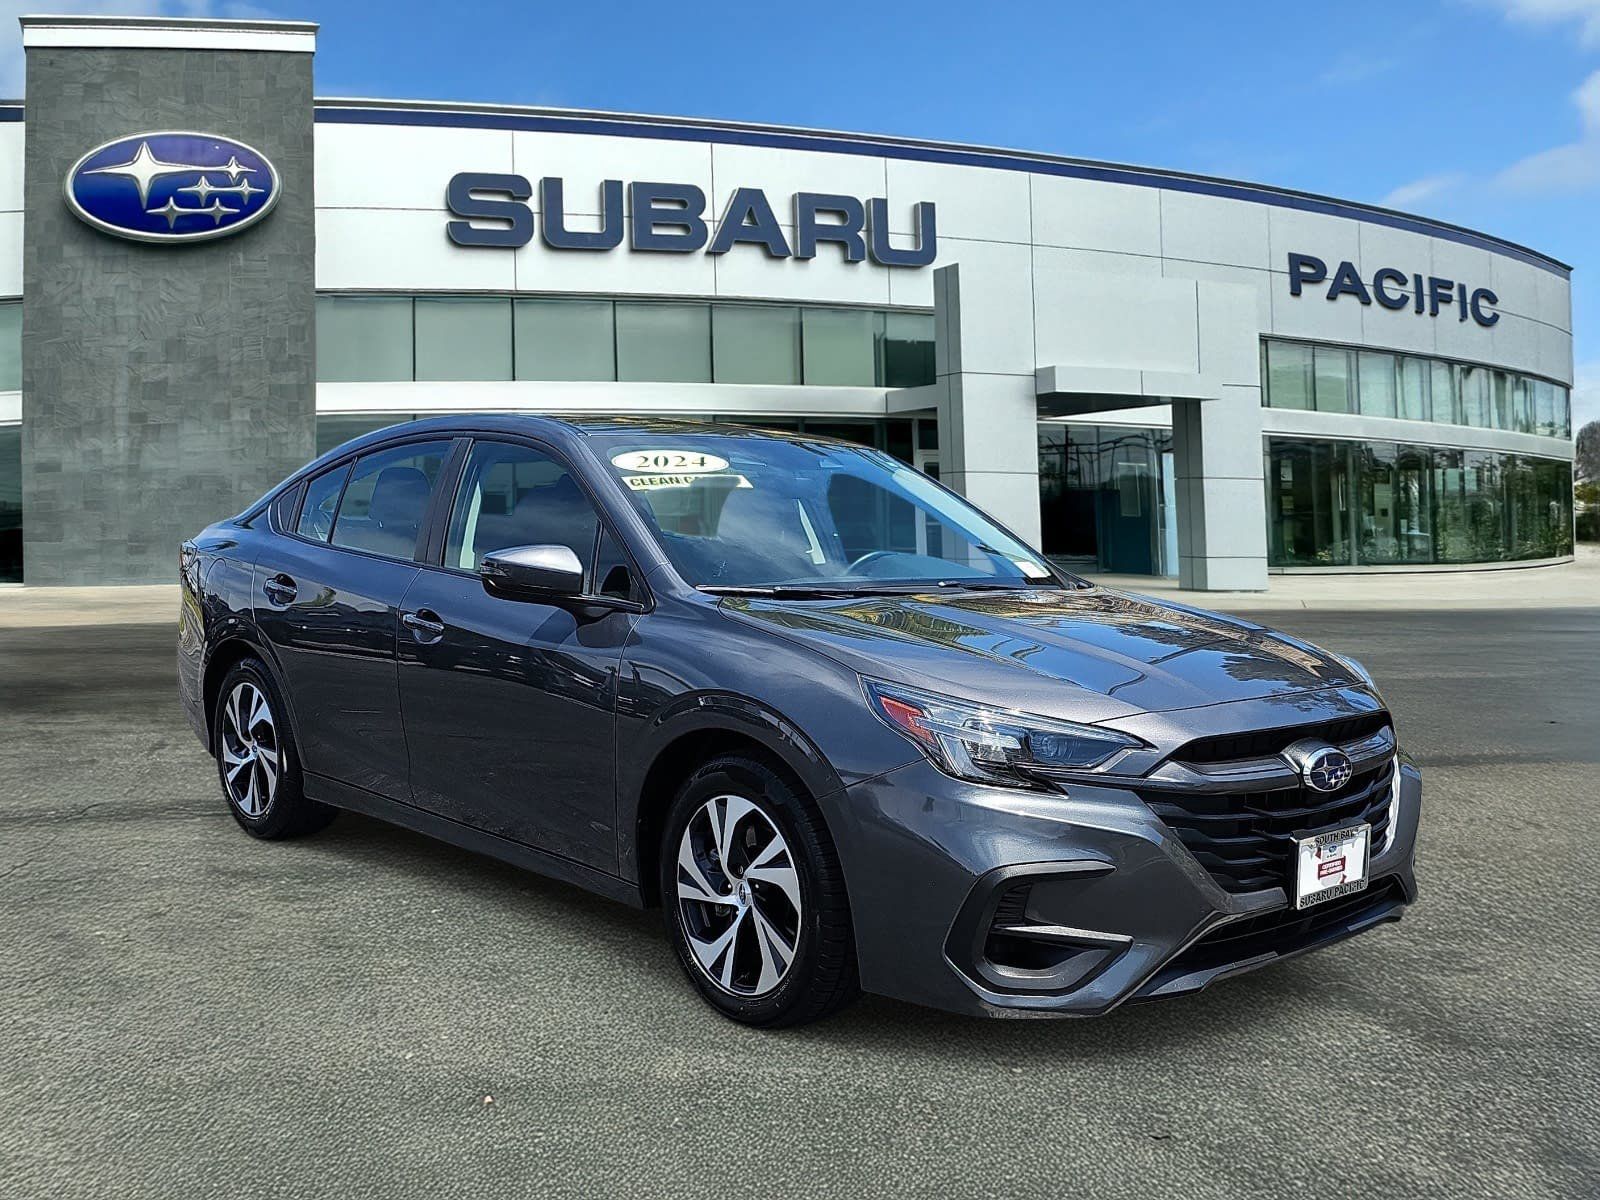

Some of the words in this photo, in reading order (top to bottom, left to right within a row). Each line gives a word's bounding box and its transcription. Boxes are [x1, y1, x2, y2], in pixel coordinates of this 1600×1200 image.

[447, 172, 936, 267] SUBARU
[1288, 252, 1500, 327] PACIFIC
[629, 476, 681, 487] CLEAN
[636, 455, 707, 468] 2024
